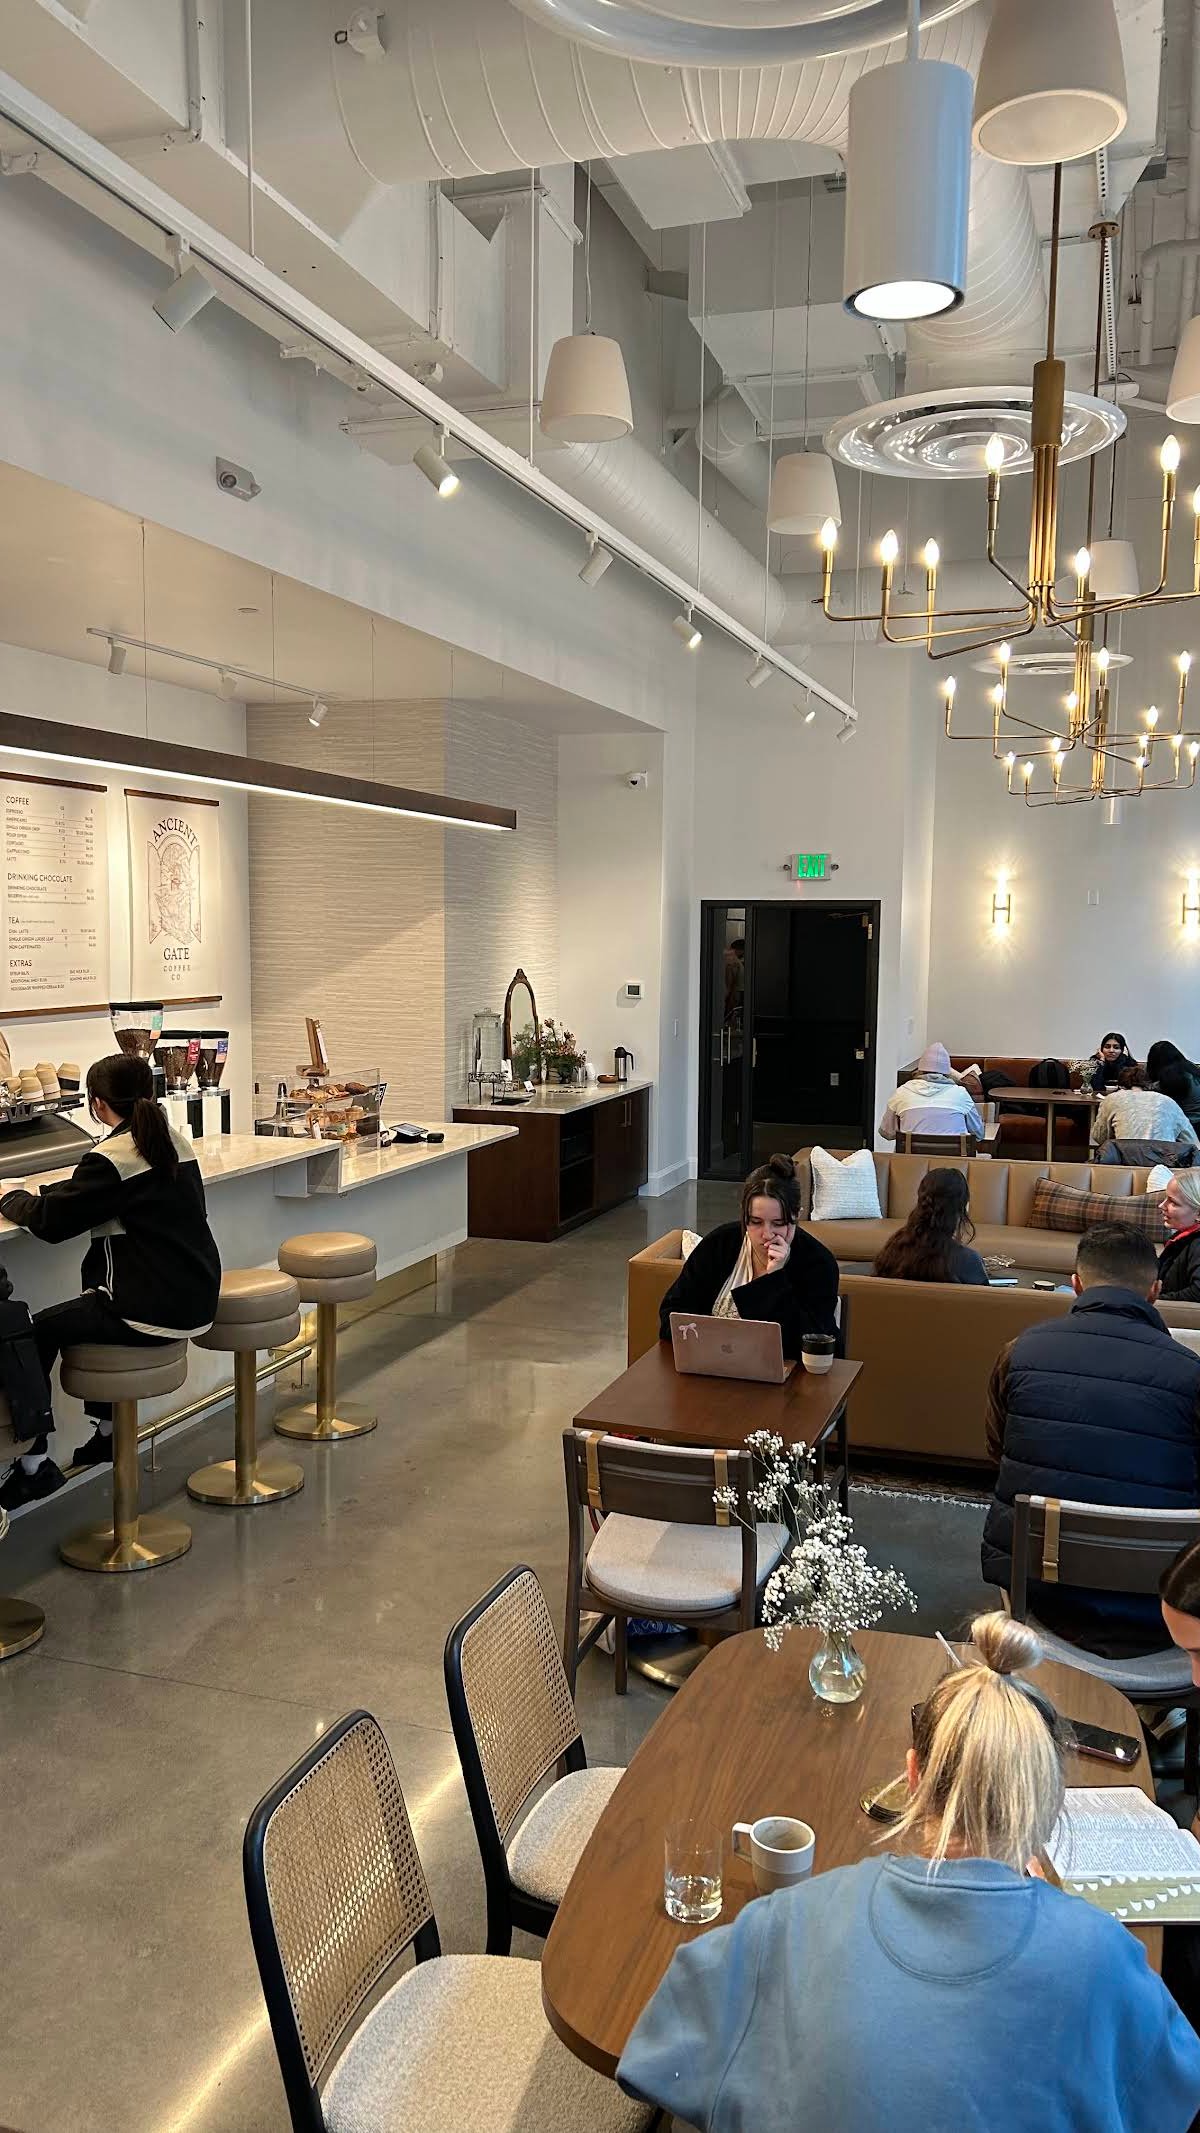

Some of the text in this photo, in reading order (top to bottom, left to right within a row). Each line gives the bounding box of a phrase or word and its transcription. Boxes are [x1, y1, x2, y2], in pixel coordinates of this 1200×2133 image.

[6, 795, 30, 806] COFFEE
[152, 818, 198, 845] ANCIENT
[798, 854, 826, 877] EXIT
[8, 873, 73, 883] DRINKING CHOCOLATE
[9, 916, 19, 924] TEA
[163, 947, 190, 961] GATE
[10, 959, 32, 967] EXTRAS
